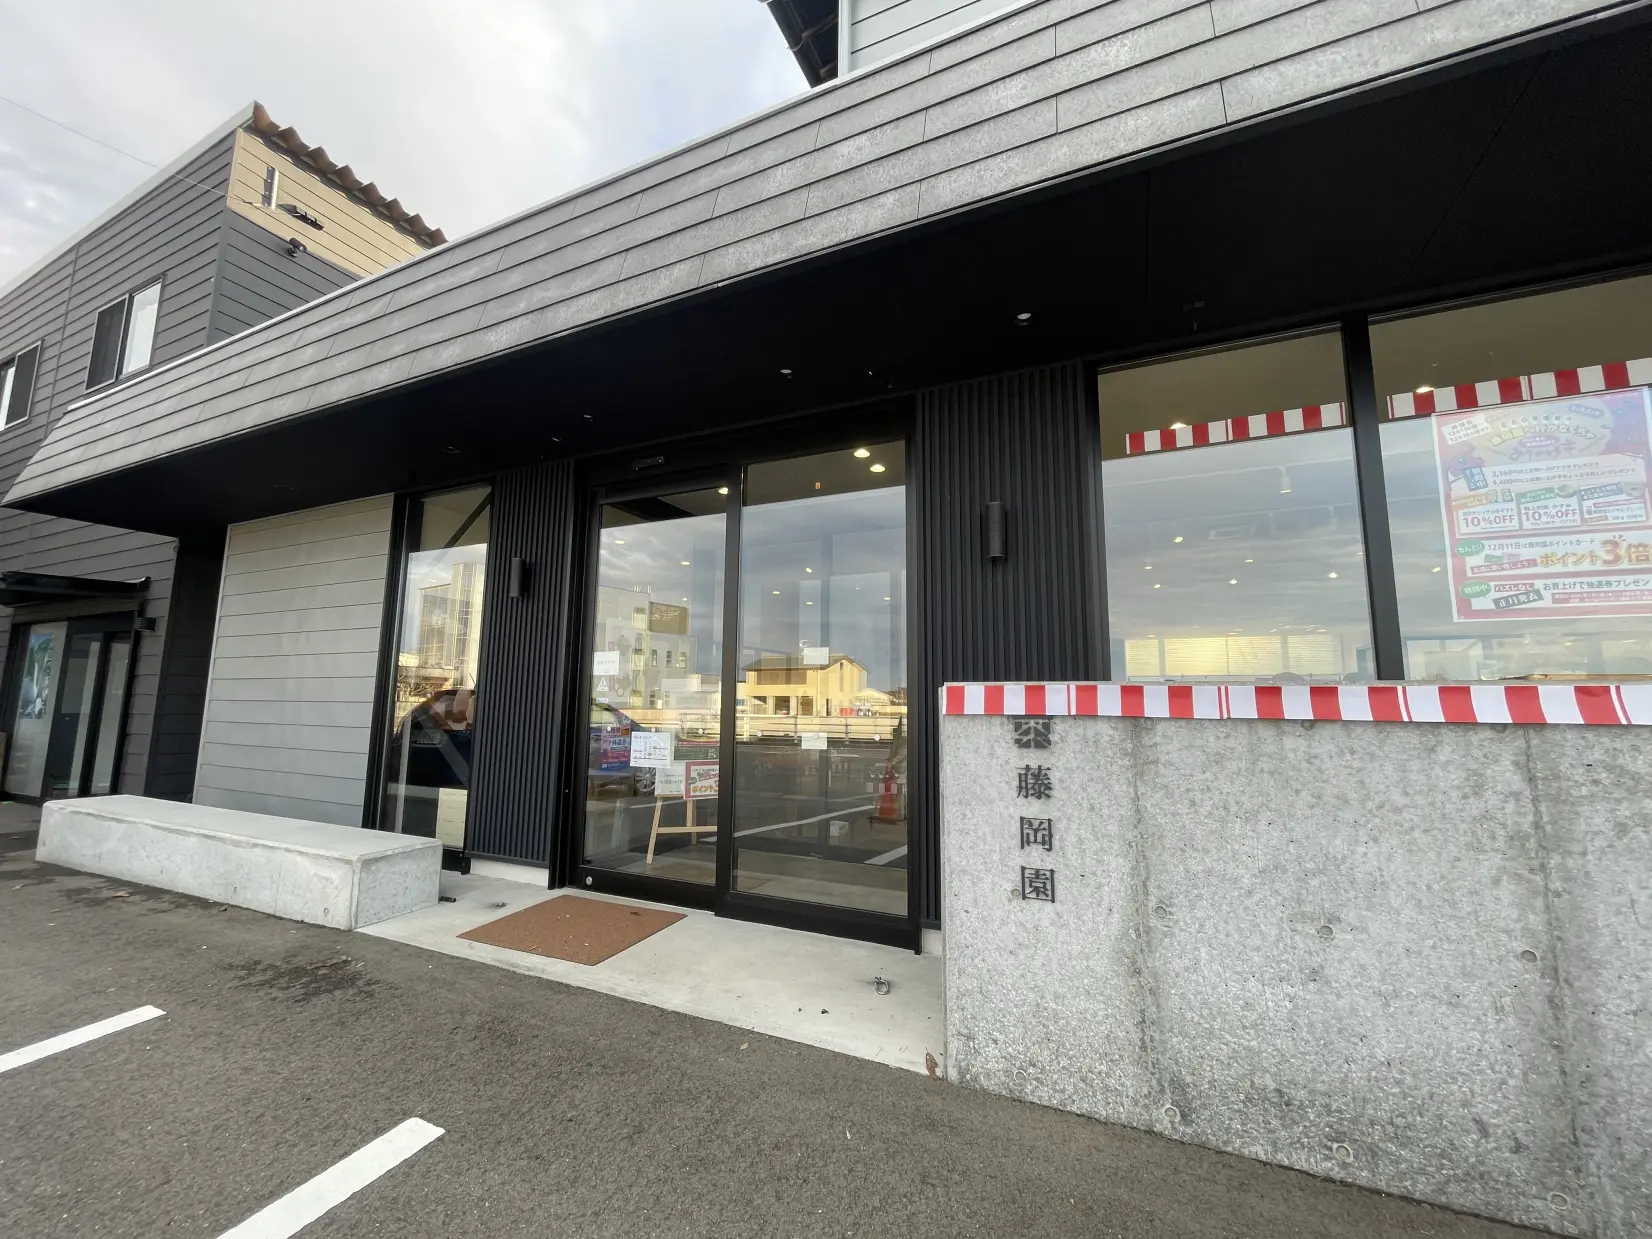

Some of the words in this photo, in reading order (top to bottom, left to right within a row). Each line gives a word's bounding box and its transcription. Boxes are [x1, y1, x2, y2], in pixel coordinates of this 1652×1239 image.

[1462, 515, 1516, 528] 10%OFF
[1523, 508, 1578, 522] 10%OFF
[1499, 592, 1539, 607] 正月発表
[1016, 764, 1056, 903] 藤岡園
